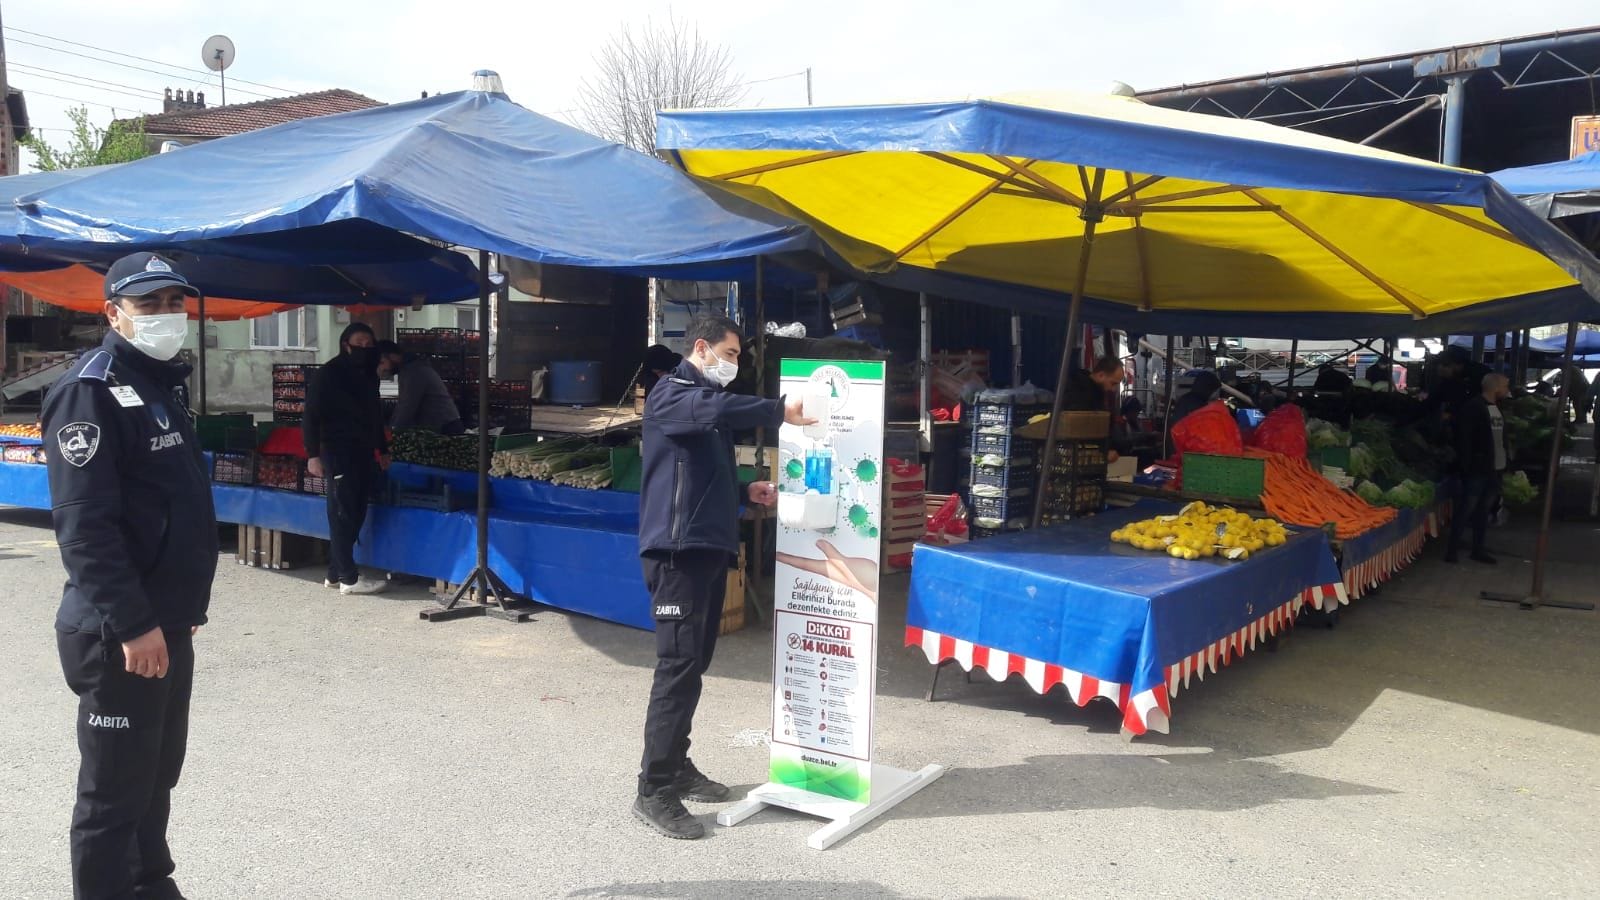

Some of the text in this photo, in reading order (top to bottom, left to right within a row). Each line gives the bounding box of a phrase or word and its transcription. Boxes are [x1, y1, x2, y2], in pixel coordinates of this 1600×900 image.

[787, 601, 831, 615] dezenfekte
[791, 591, 856, 608] Ellerinizi burada
[656, 605, 681, 616] ZABITA
[802, 639, 814, 652] 14
[816, 641, 855, 659] KURAL
[88, 712, 130, 729] ZABITA
